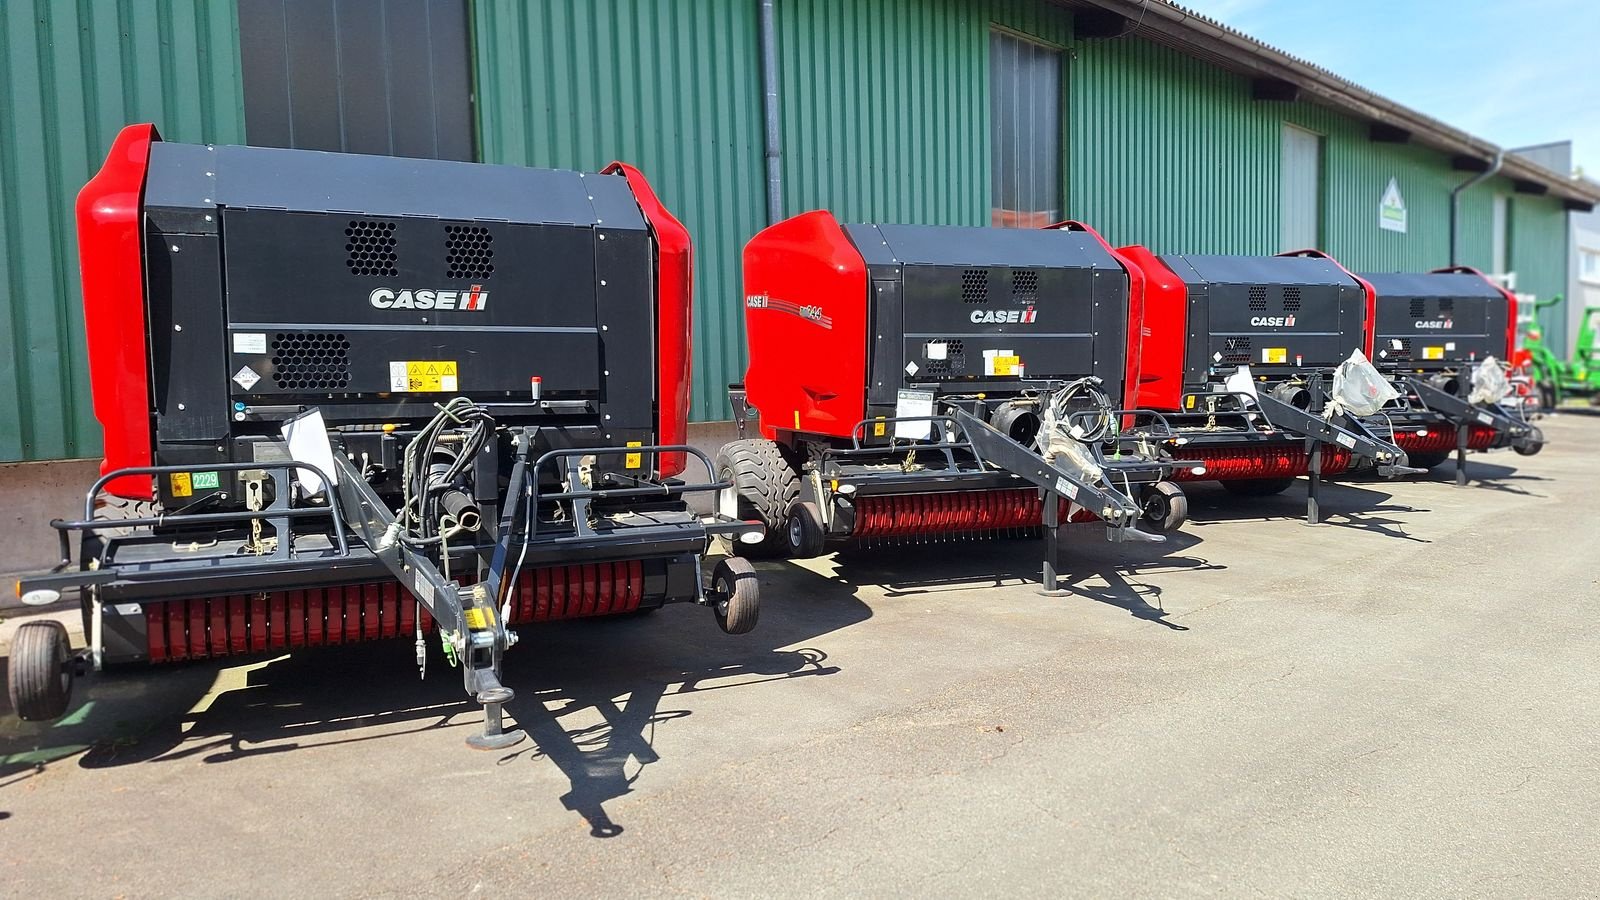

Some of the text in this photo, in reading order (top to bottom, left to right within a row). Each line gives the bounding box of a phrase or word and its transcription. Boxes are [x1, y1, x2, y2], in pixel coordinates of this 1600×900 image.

[369, 288, 458, 310] CASE
[746, 295, 762, 308] CASE
[970, 309, 1020, 324] CASE
[1250, 316, 1284, 327] CASE
[1414, 320, 1443, 329] CASE
[193, 473, 217, 487] 2229
